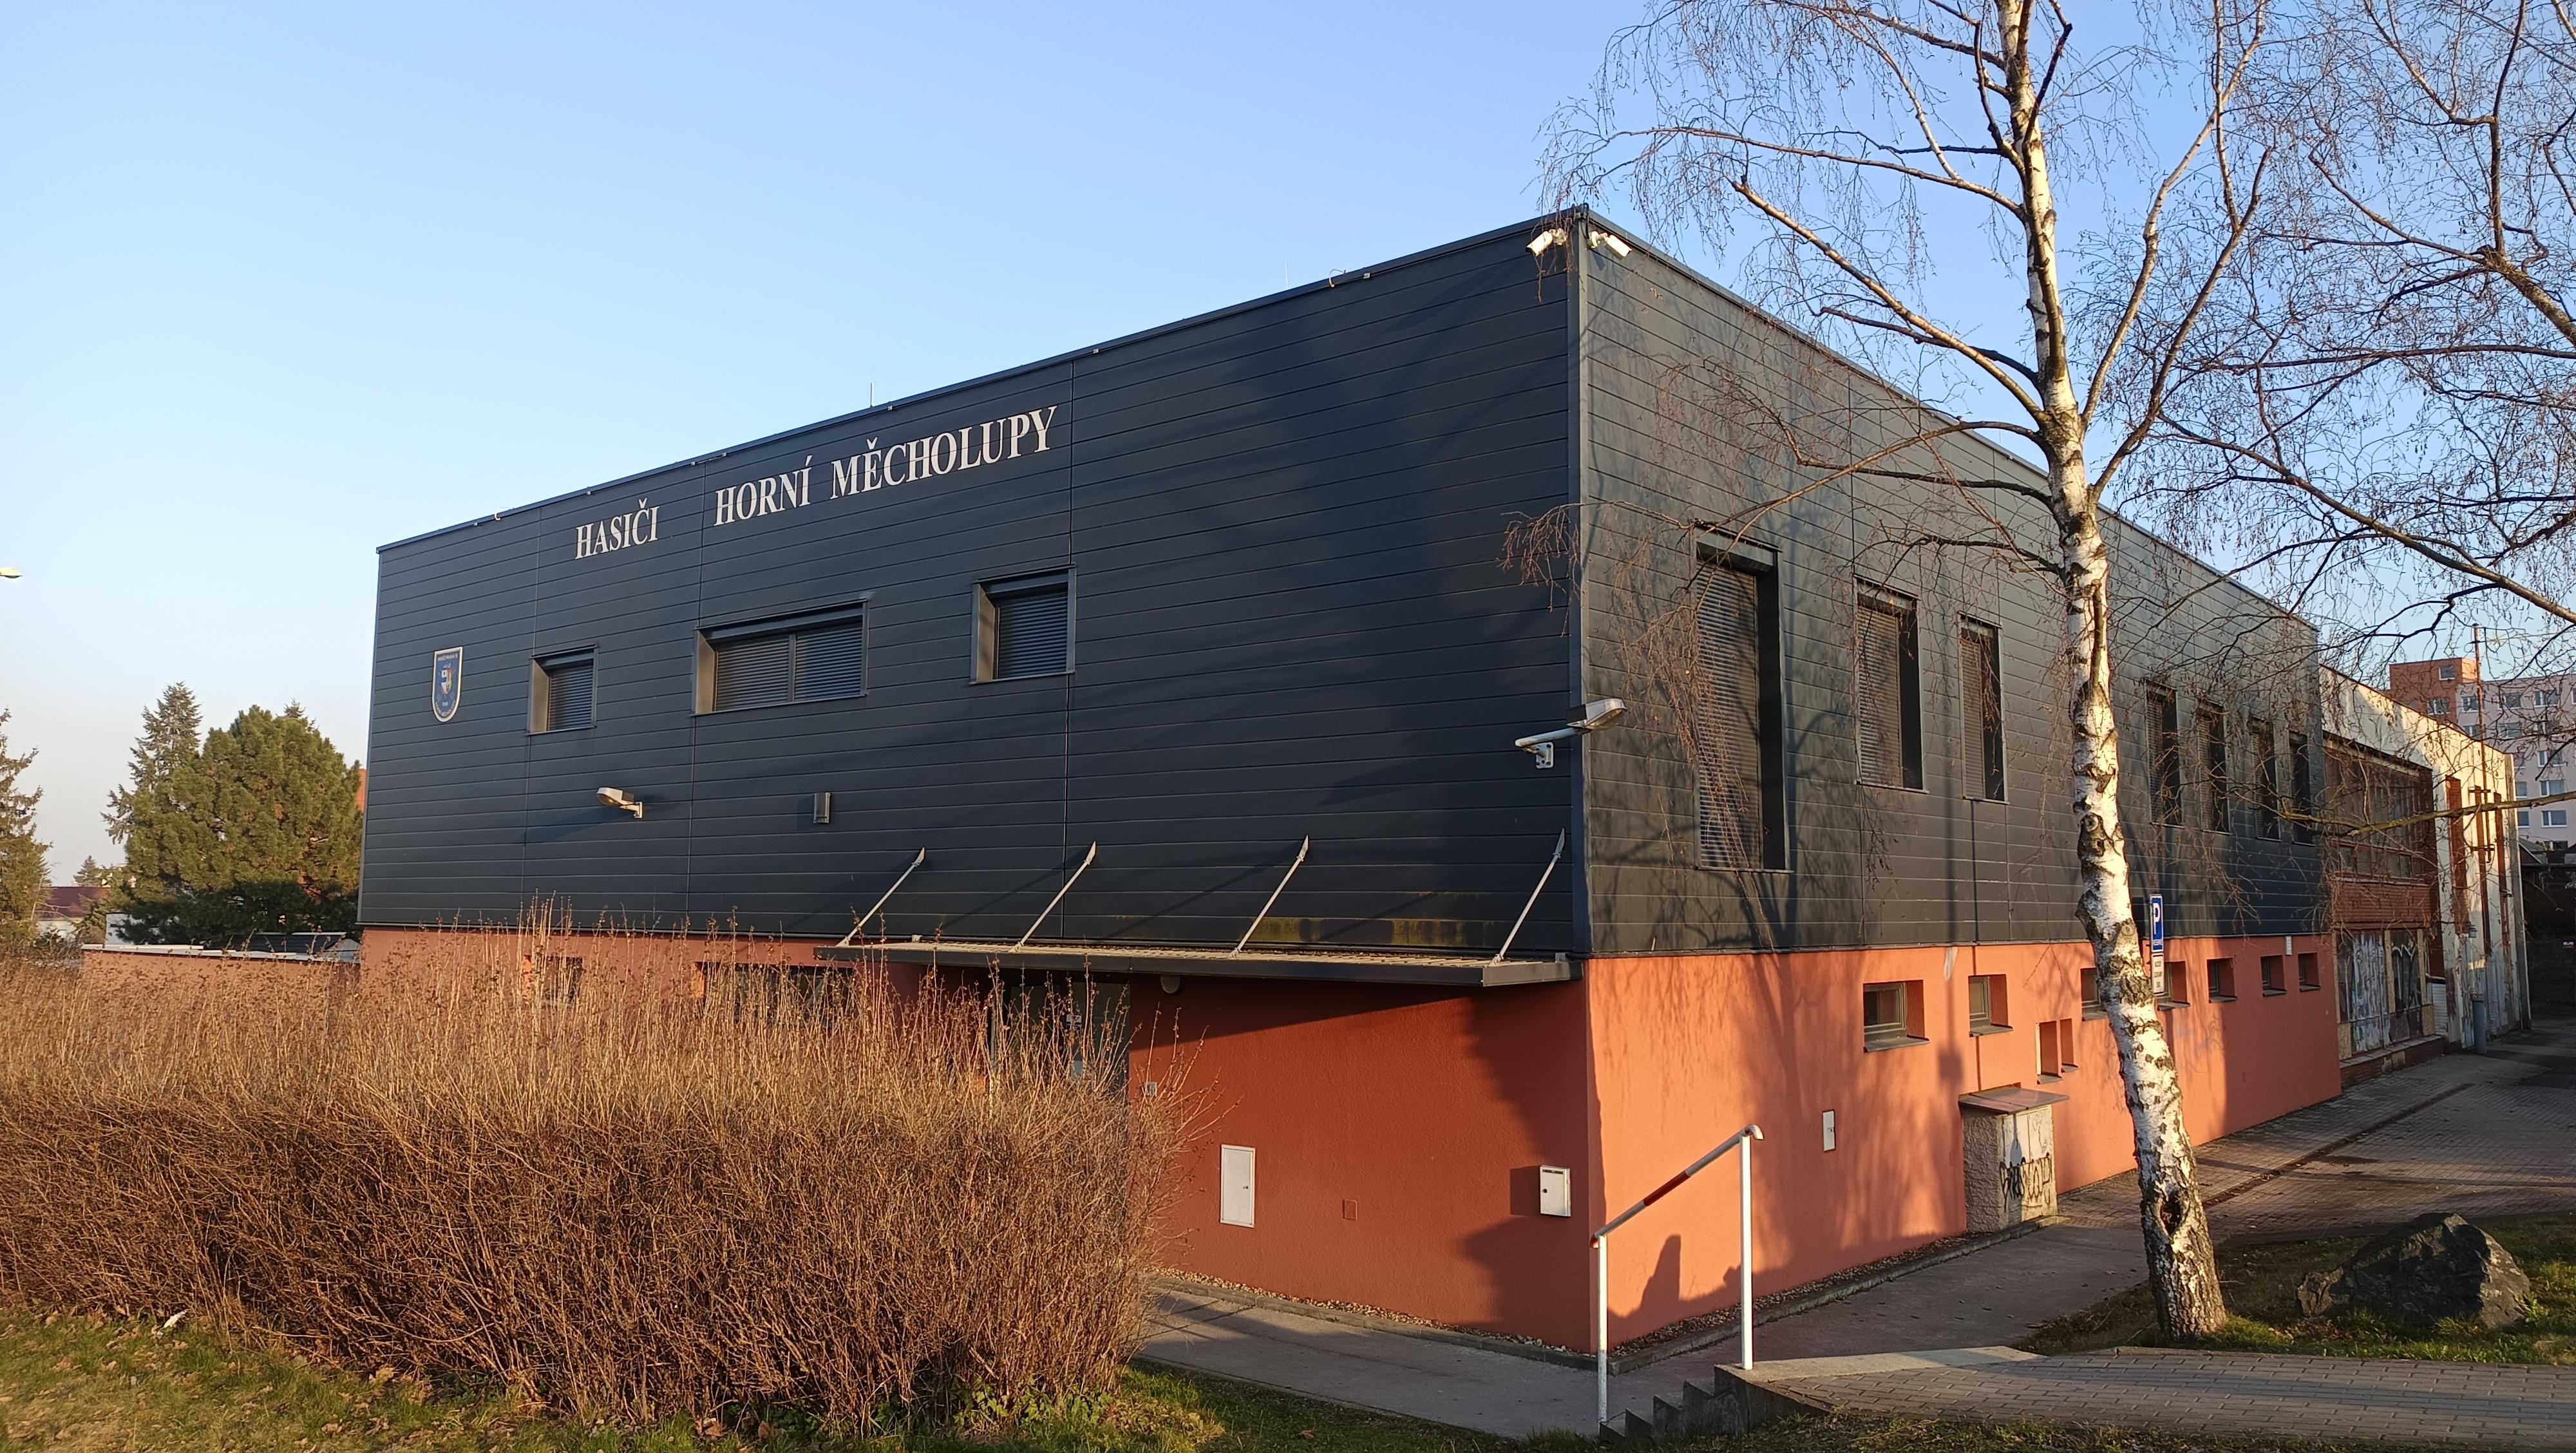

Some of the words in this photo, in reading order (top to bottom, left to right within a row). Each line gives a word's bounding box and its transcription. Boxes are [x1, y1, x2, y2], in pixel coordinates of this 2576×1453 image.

[574, 497, 660, 560] HASIČI
[713, 455, 813, 526] HORNÍ
[829, 405, 1057, 500] MĚCHOLUPY
[2153, 902, 2161, 935] P
